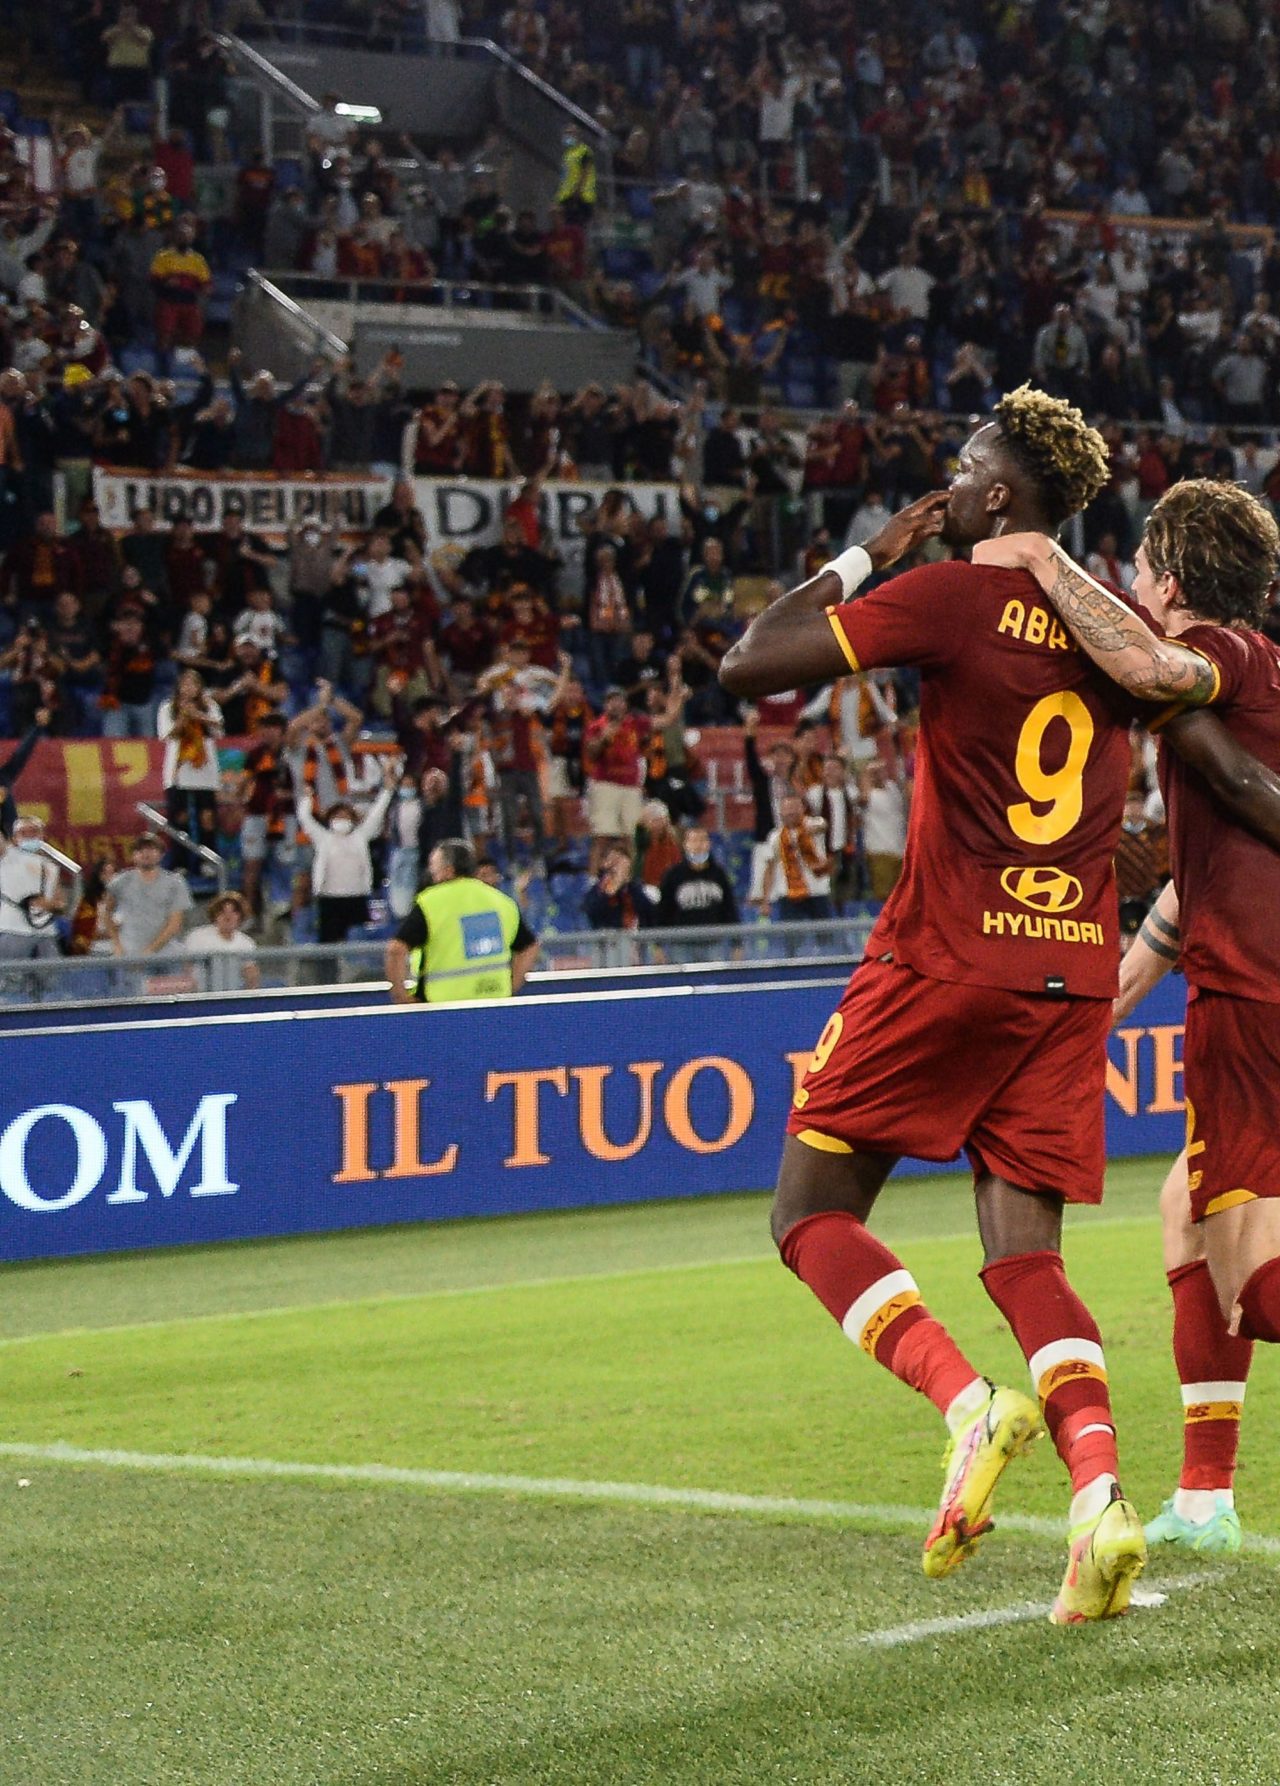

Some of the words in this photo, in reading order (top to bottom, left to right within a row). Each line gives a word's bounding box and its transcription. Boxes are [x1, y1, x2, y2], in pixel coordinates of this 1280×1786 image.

[1007, 690, 1094, 845] 9
[983, 910, 1105, 946] HYUNDAI
[0, 1093, 240, 1213] OM
[331, 1078, 459, 1184] IL
[485, 1055, 755, 1169] TUO
